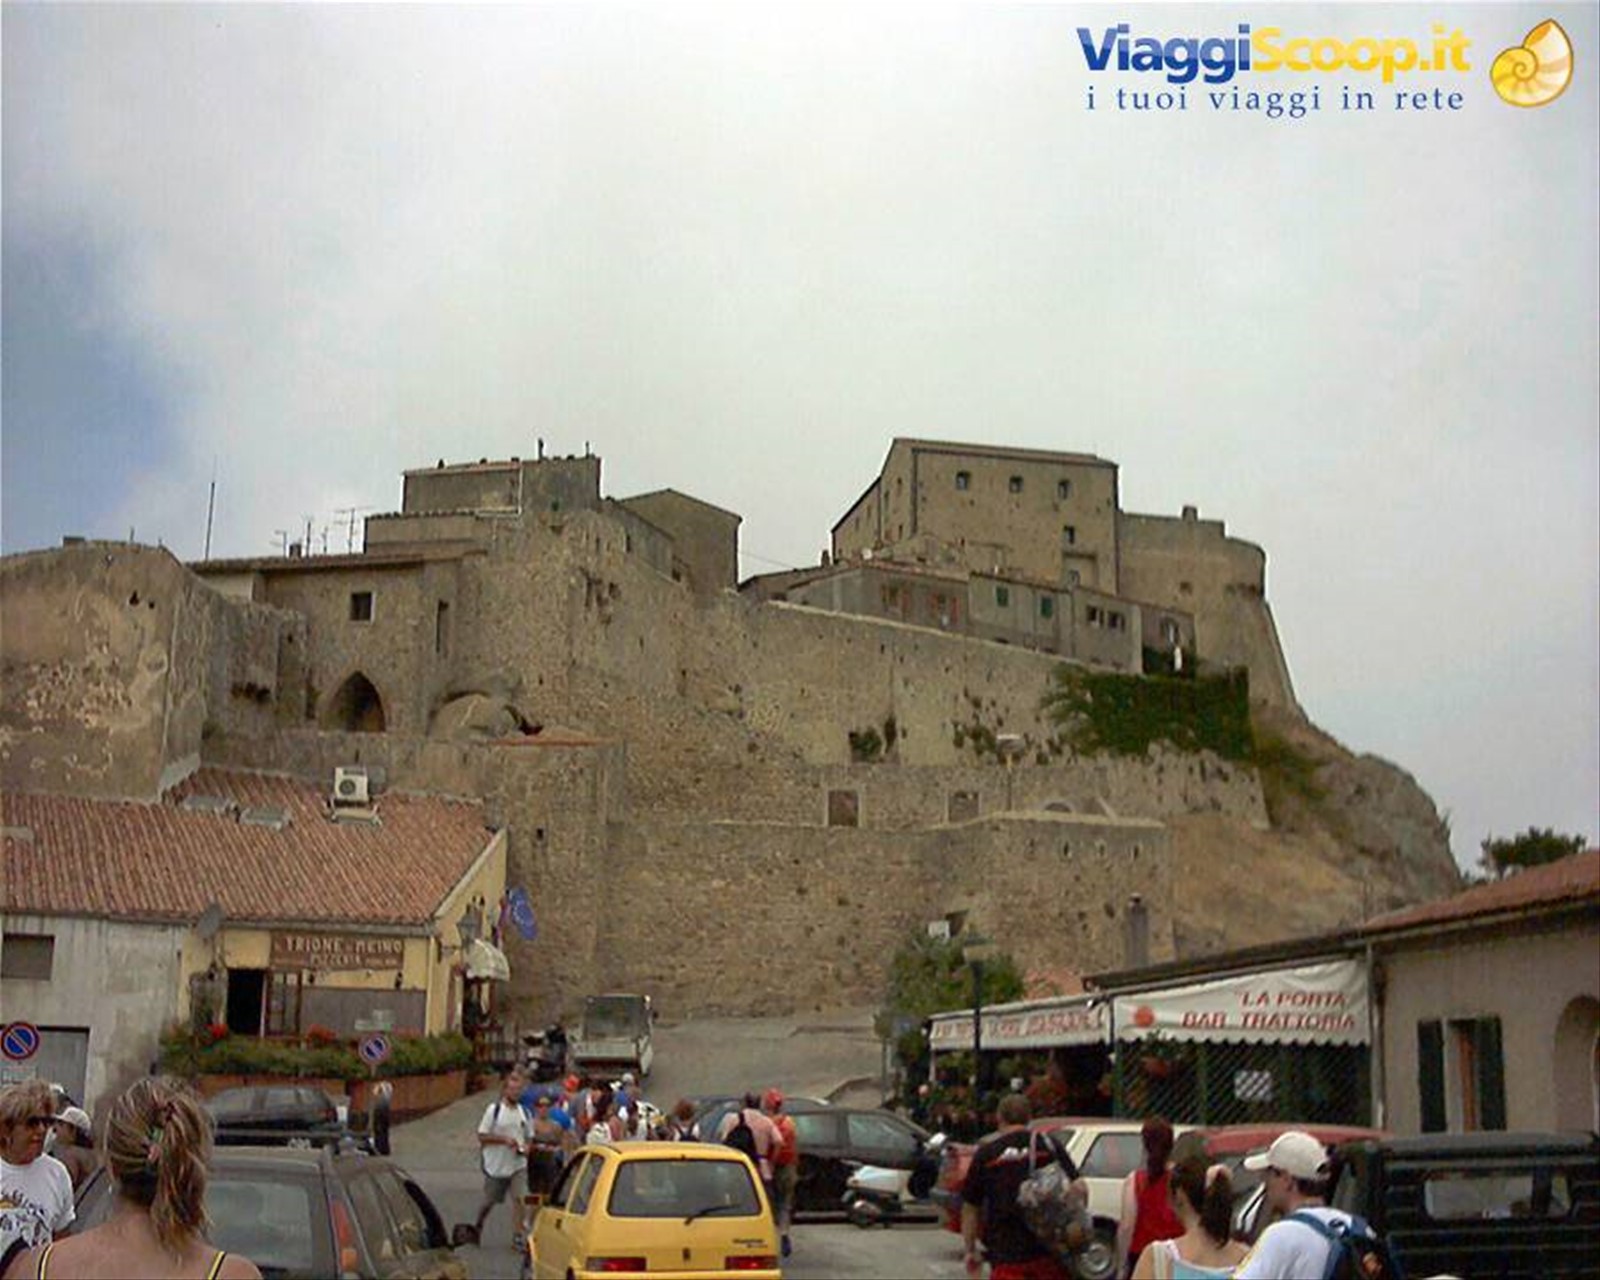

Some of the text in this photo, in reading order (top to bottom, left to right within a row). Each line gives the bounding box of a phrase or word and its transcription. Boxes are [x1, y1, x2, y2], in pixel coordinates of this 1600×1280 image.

[1276, 990, 1347, 1008] PORTA
[1182, 1011, 1356, 1030] BAR TRATTORIA
